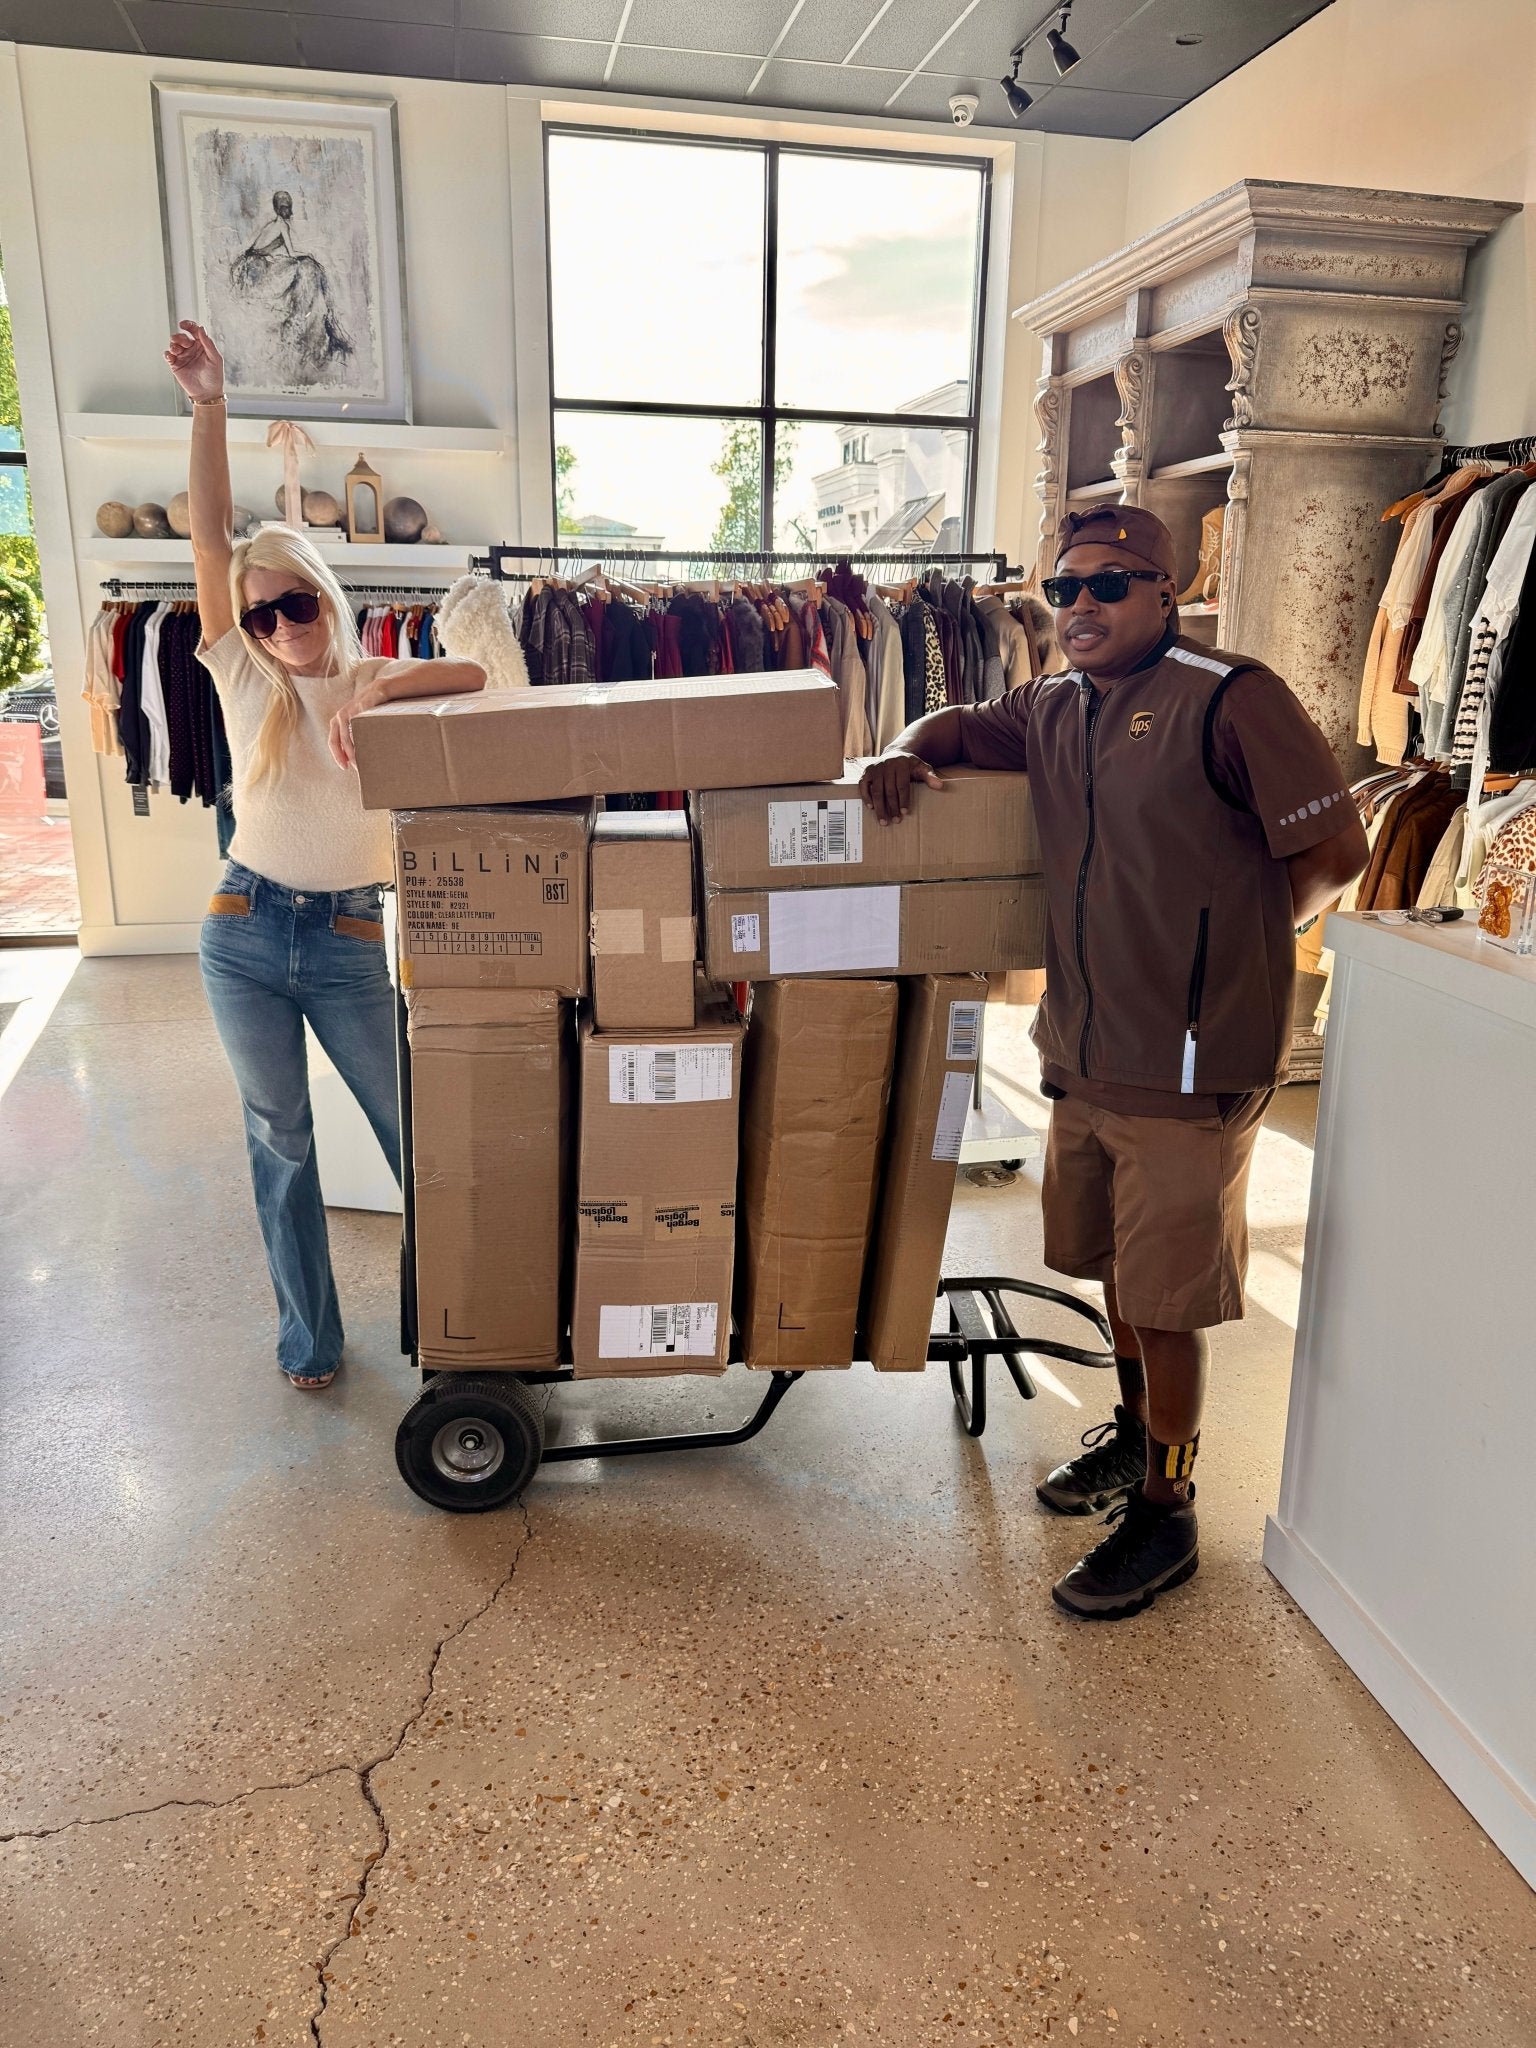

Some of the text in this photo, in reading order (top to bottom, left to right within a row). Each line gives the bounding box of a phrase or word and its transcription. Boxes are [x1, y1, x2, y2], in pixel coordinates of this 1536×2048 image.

[1131, 720, 1151, 736] ups
[436, 876, 465, 887] 25538
[406, 889, 425, 898] STYLE
[406, 900, 430, 909] STYLEE
[407, 911, 437, 920] COLOUR:
[475, 912, 497, 920] PATENT
[407, 921, 425, 930] PACK
[496, 933, 505, 941] 10
[510, 933, 518, 941] 11
[523, 933, 540, 942] TOTAL
[578, 1206, 616, 1217] Logistic
[594, 1215, 628, 1223] Bergen
[666, 1219, 700, 1229] Bergen
